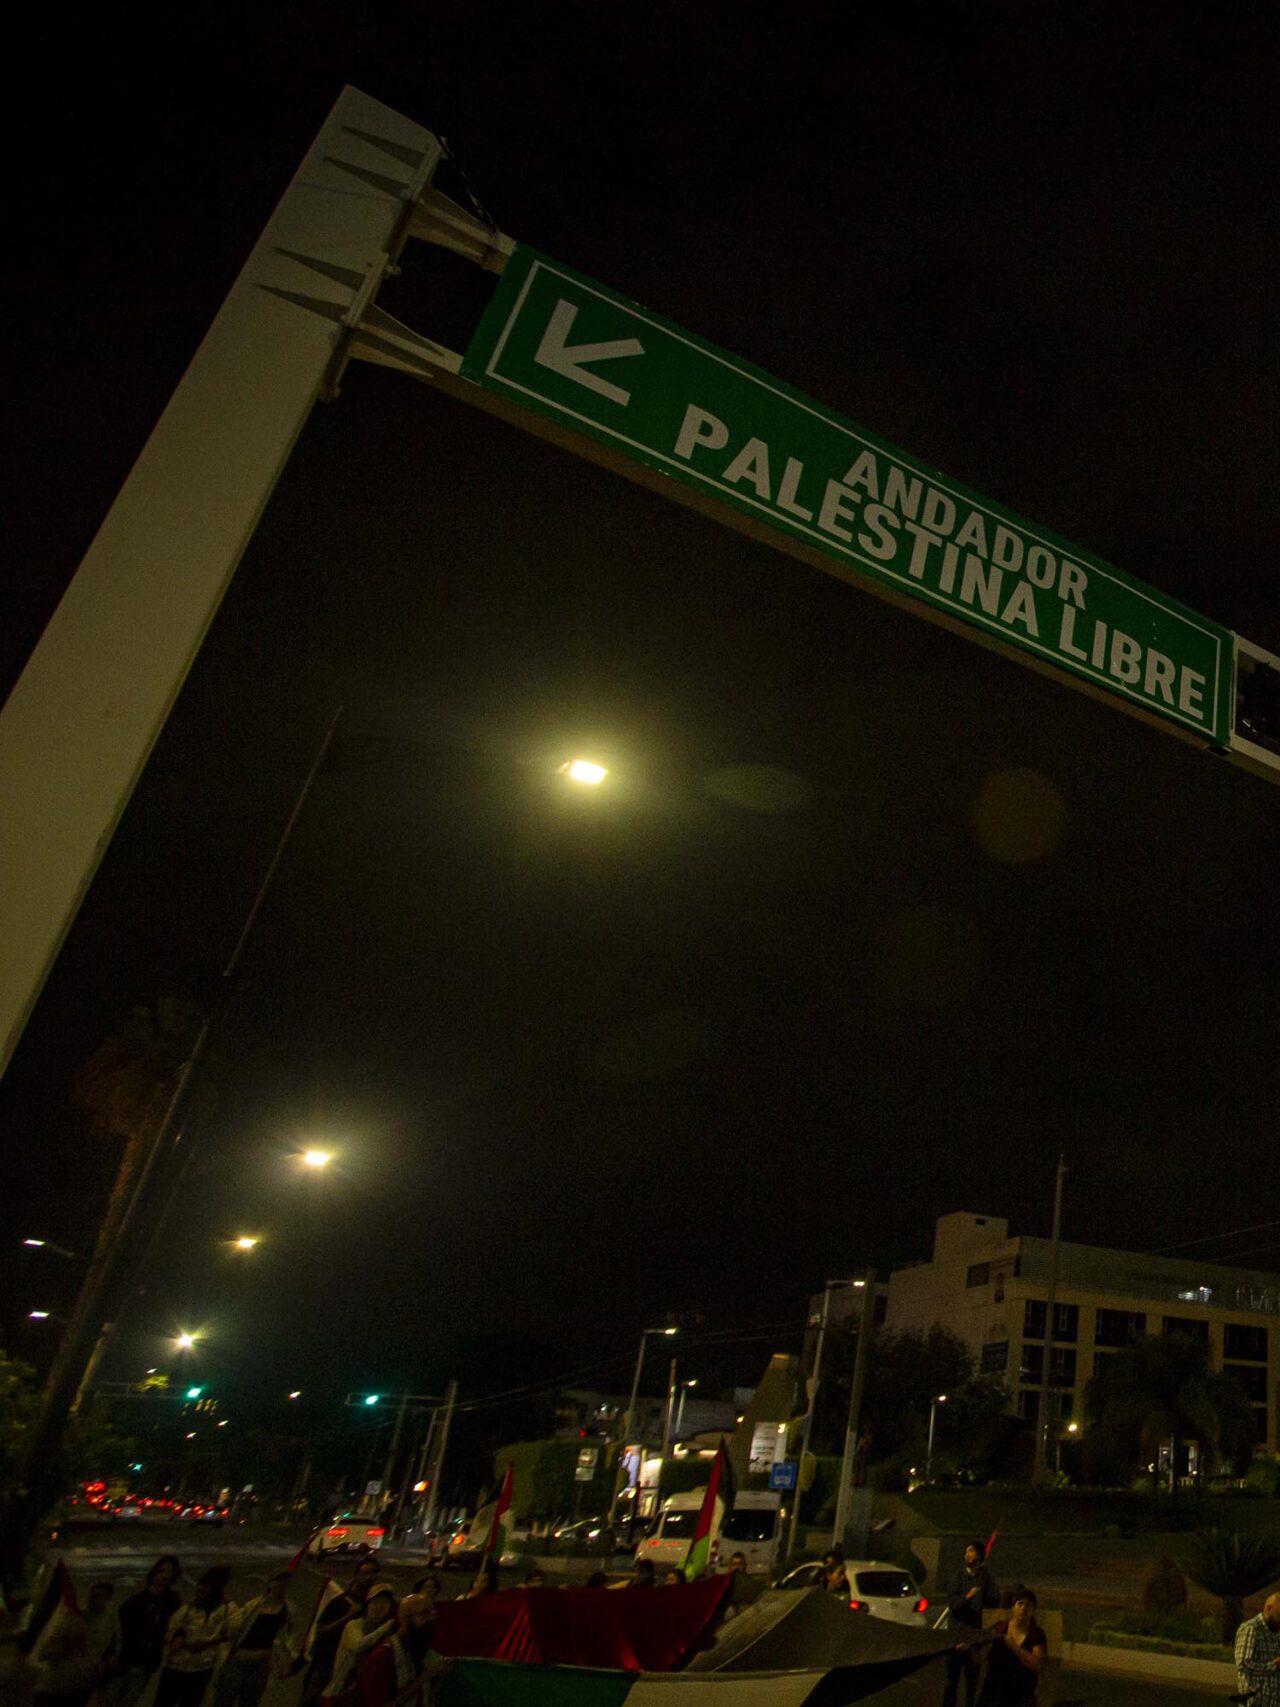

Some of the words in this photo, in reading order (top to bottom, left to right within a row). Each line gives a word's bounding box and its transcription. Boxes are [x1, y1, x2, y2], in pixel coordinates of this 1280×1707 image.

[673, 403, 1039, 638] PALESTINA
[1058, 603, 1205, 721] LIBRE
[842, 450, 1088, 612] ANDADOR
